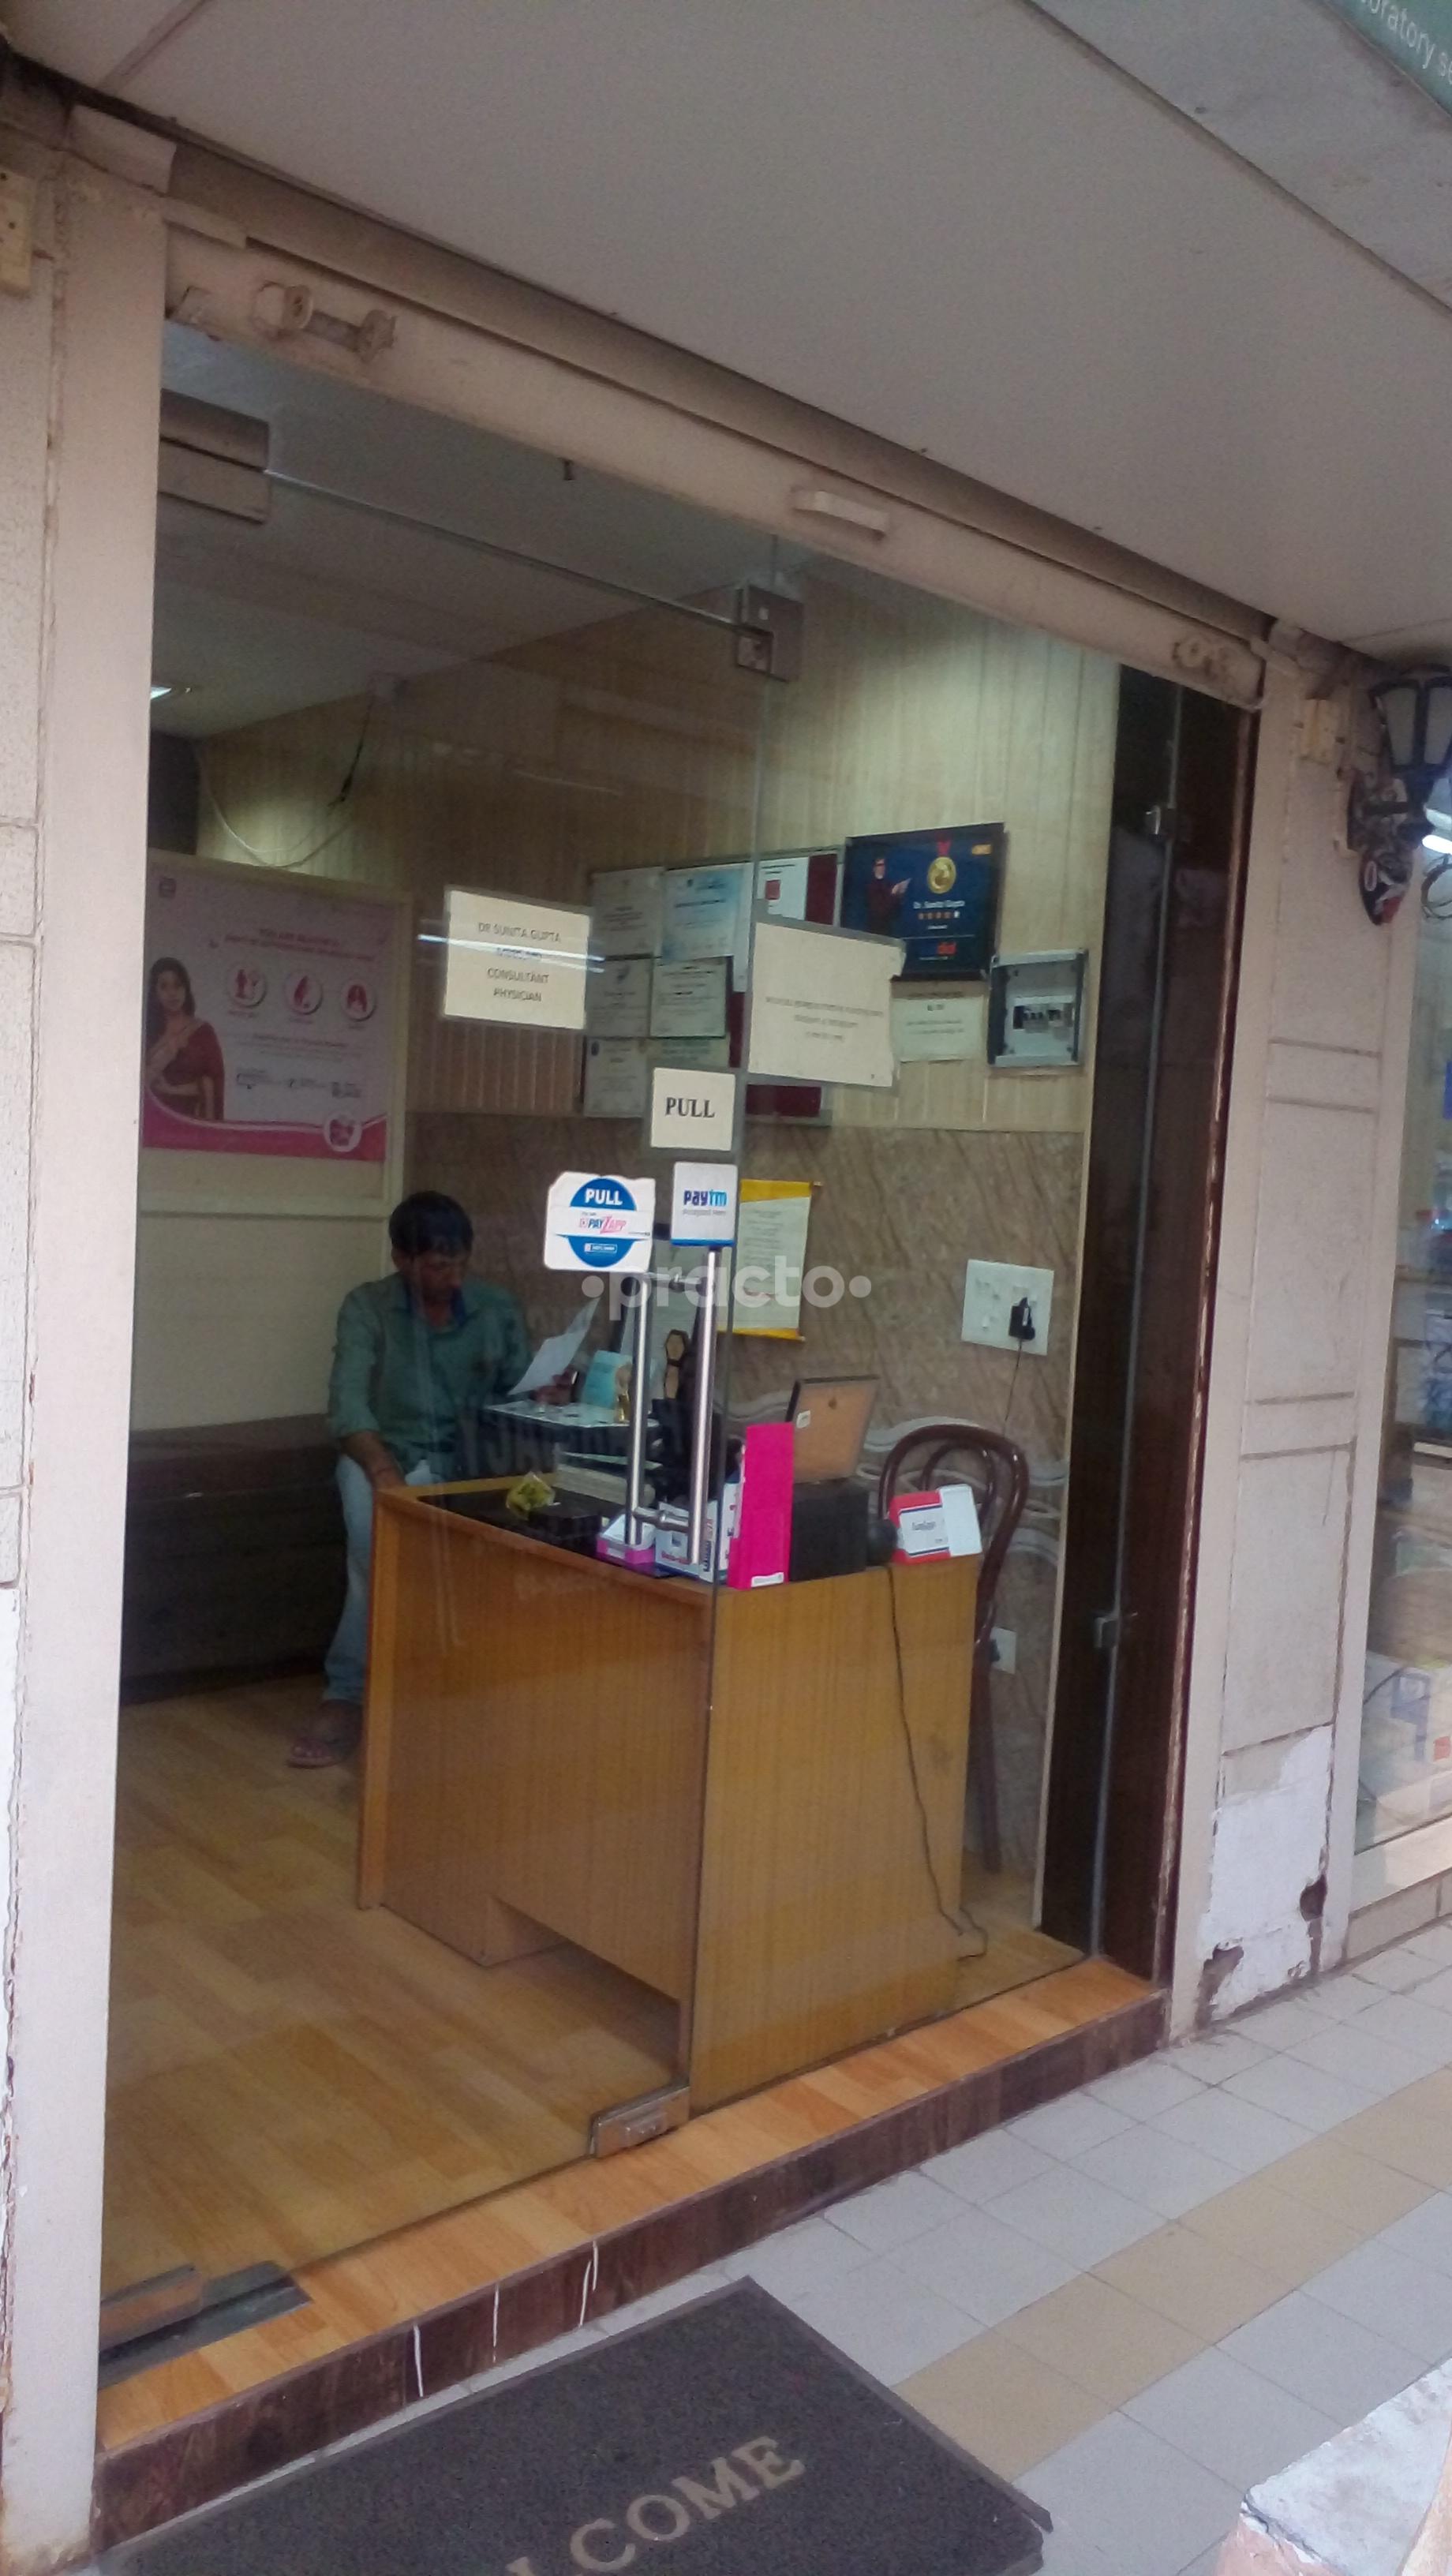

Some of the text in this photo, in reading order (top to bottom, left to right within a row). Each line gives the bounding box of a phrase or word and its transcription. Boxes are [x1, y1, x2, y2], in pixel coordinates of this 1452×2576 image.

[1360, 0, 1436, 69] oratory
[487, 968, 550, 983] CONSULTANT
[493, 988, 542, 1002] PHYSICIAN
[664, 1096, 716, 1118] PULL
[585, 1188, 623, 1205] PULL
[507, 2436, 805, 2576] COME
